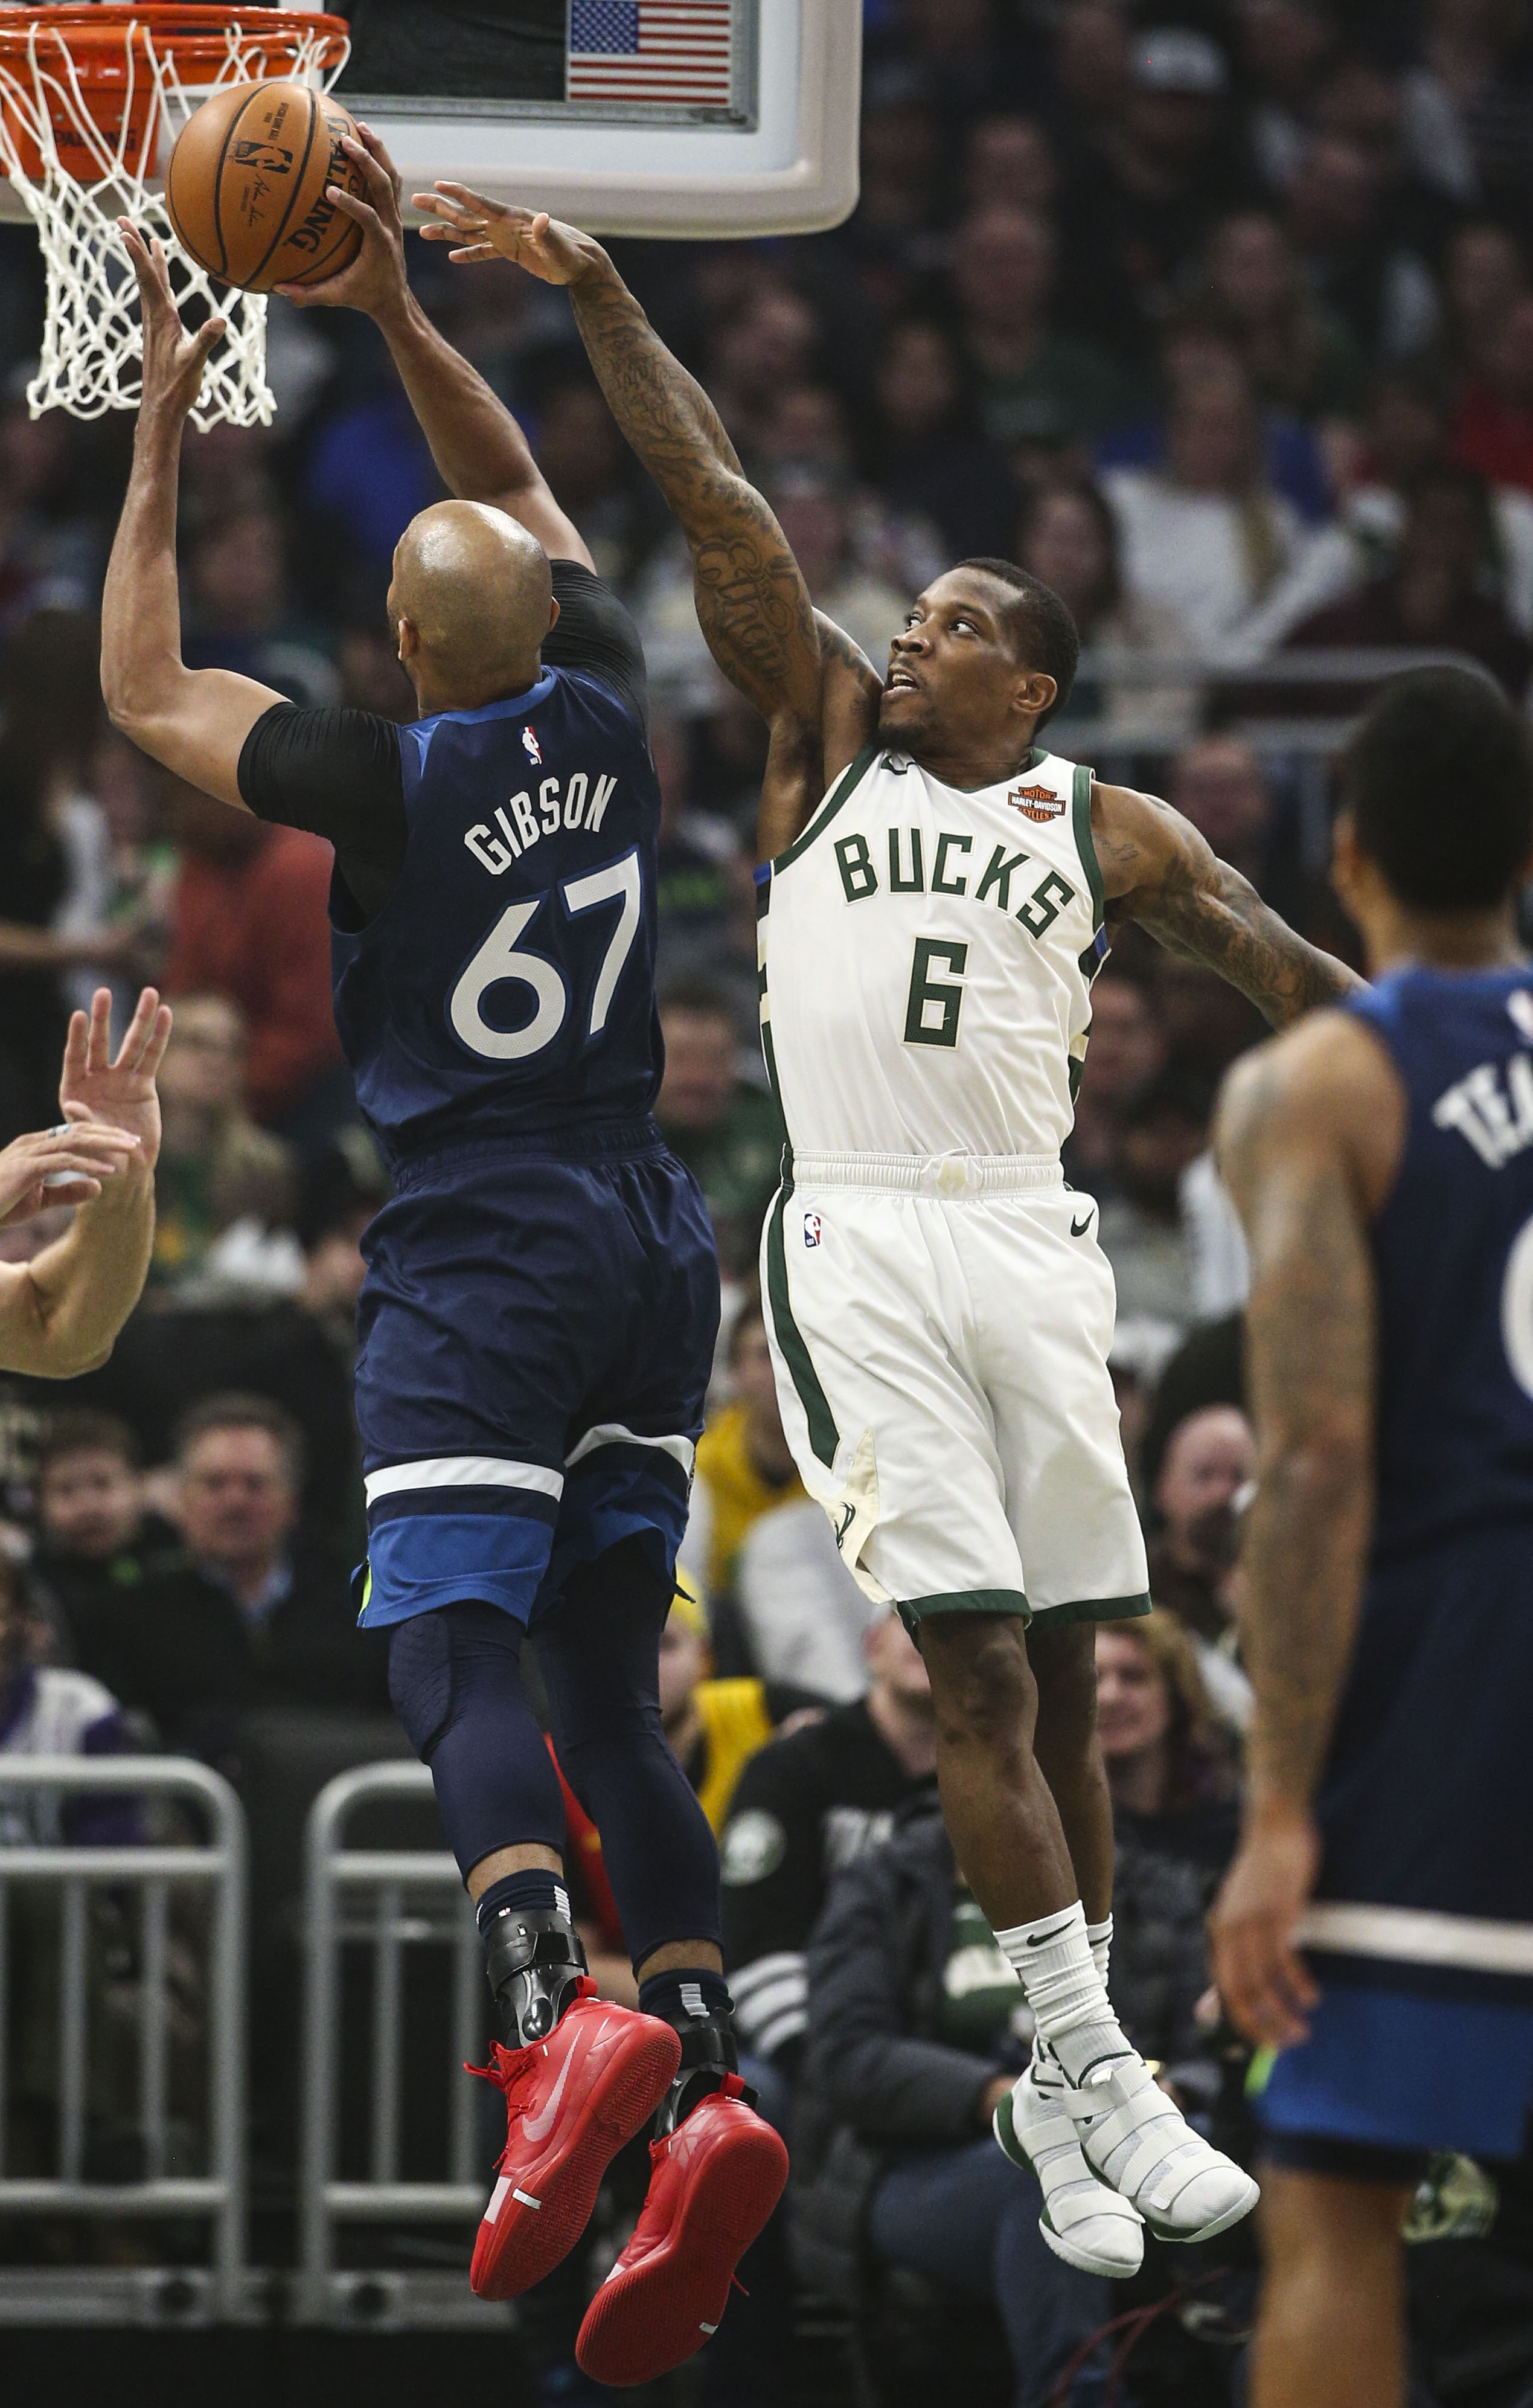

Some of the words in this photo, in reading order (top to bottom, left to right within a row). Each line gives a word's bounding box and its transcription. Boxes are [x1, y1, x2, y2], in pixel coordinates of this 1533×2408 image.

[463, 772, 618, 875] GIBSON
[1011, 796, 1063, 812] HARLEY-DAVIDSON
[1022, 809, 1049, 821] CYCLES
[1023, 788, 1051, 800] MOTOR
[833, 827, 1076, 941] BUCKS
[448, 849, 641, 1061] 67
[901, 936, 972, 1051] 6
